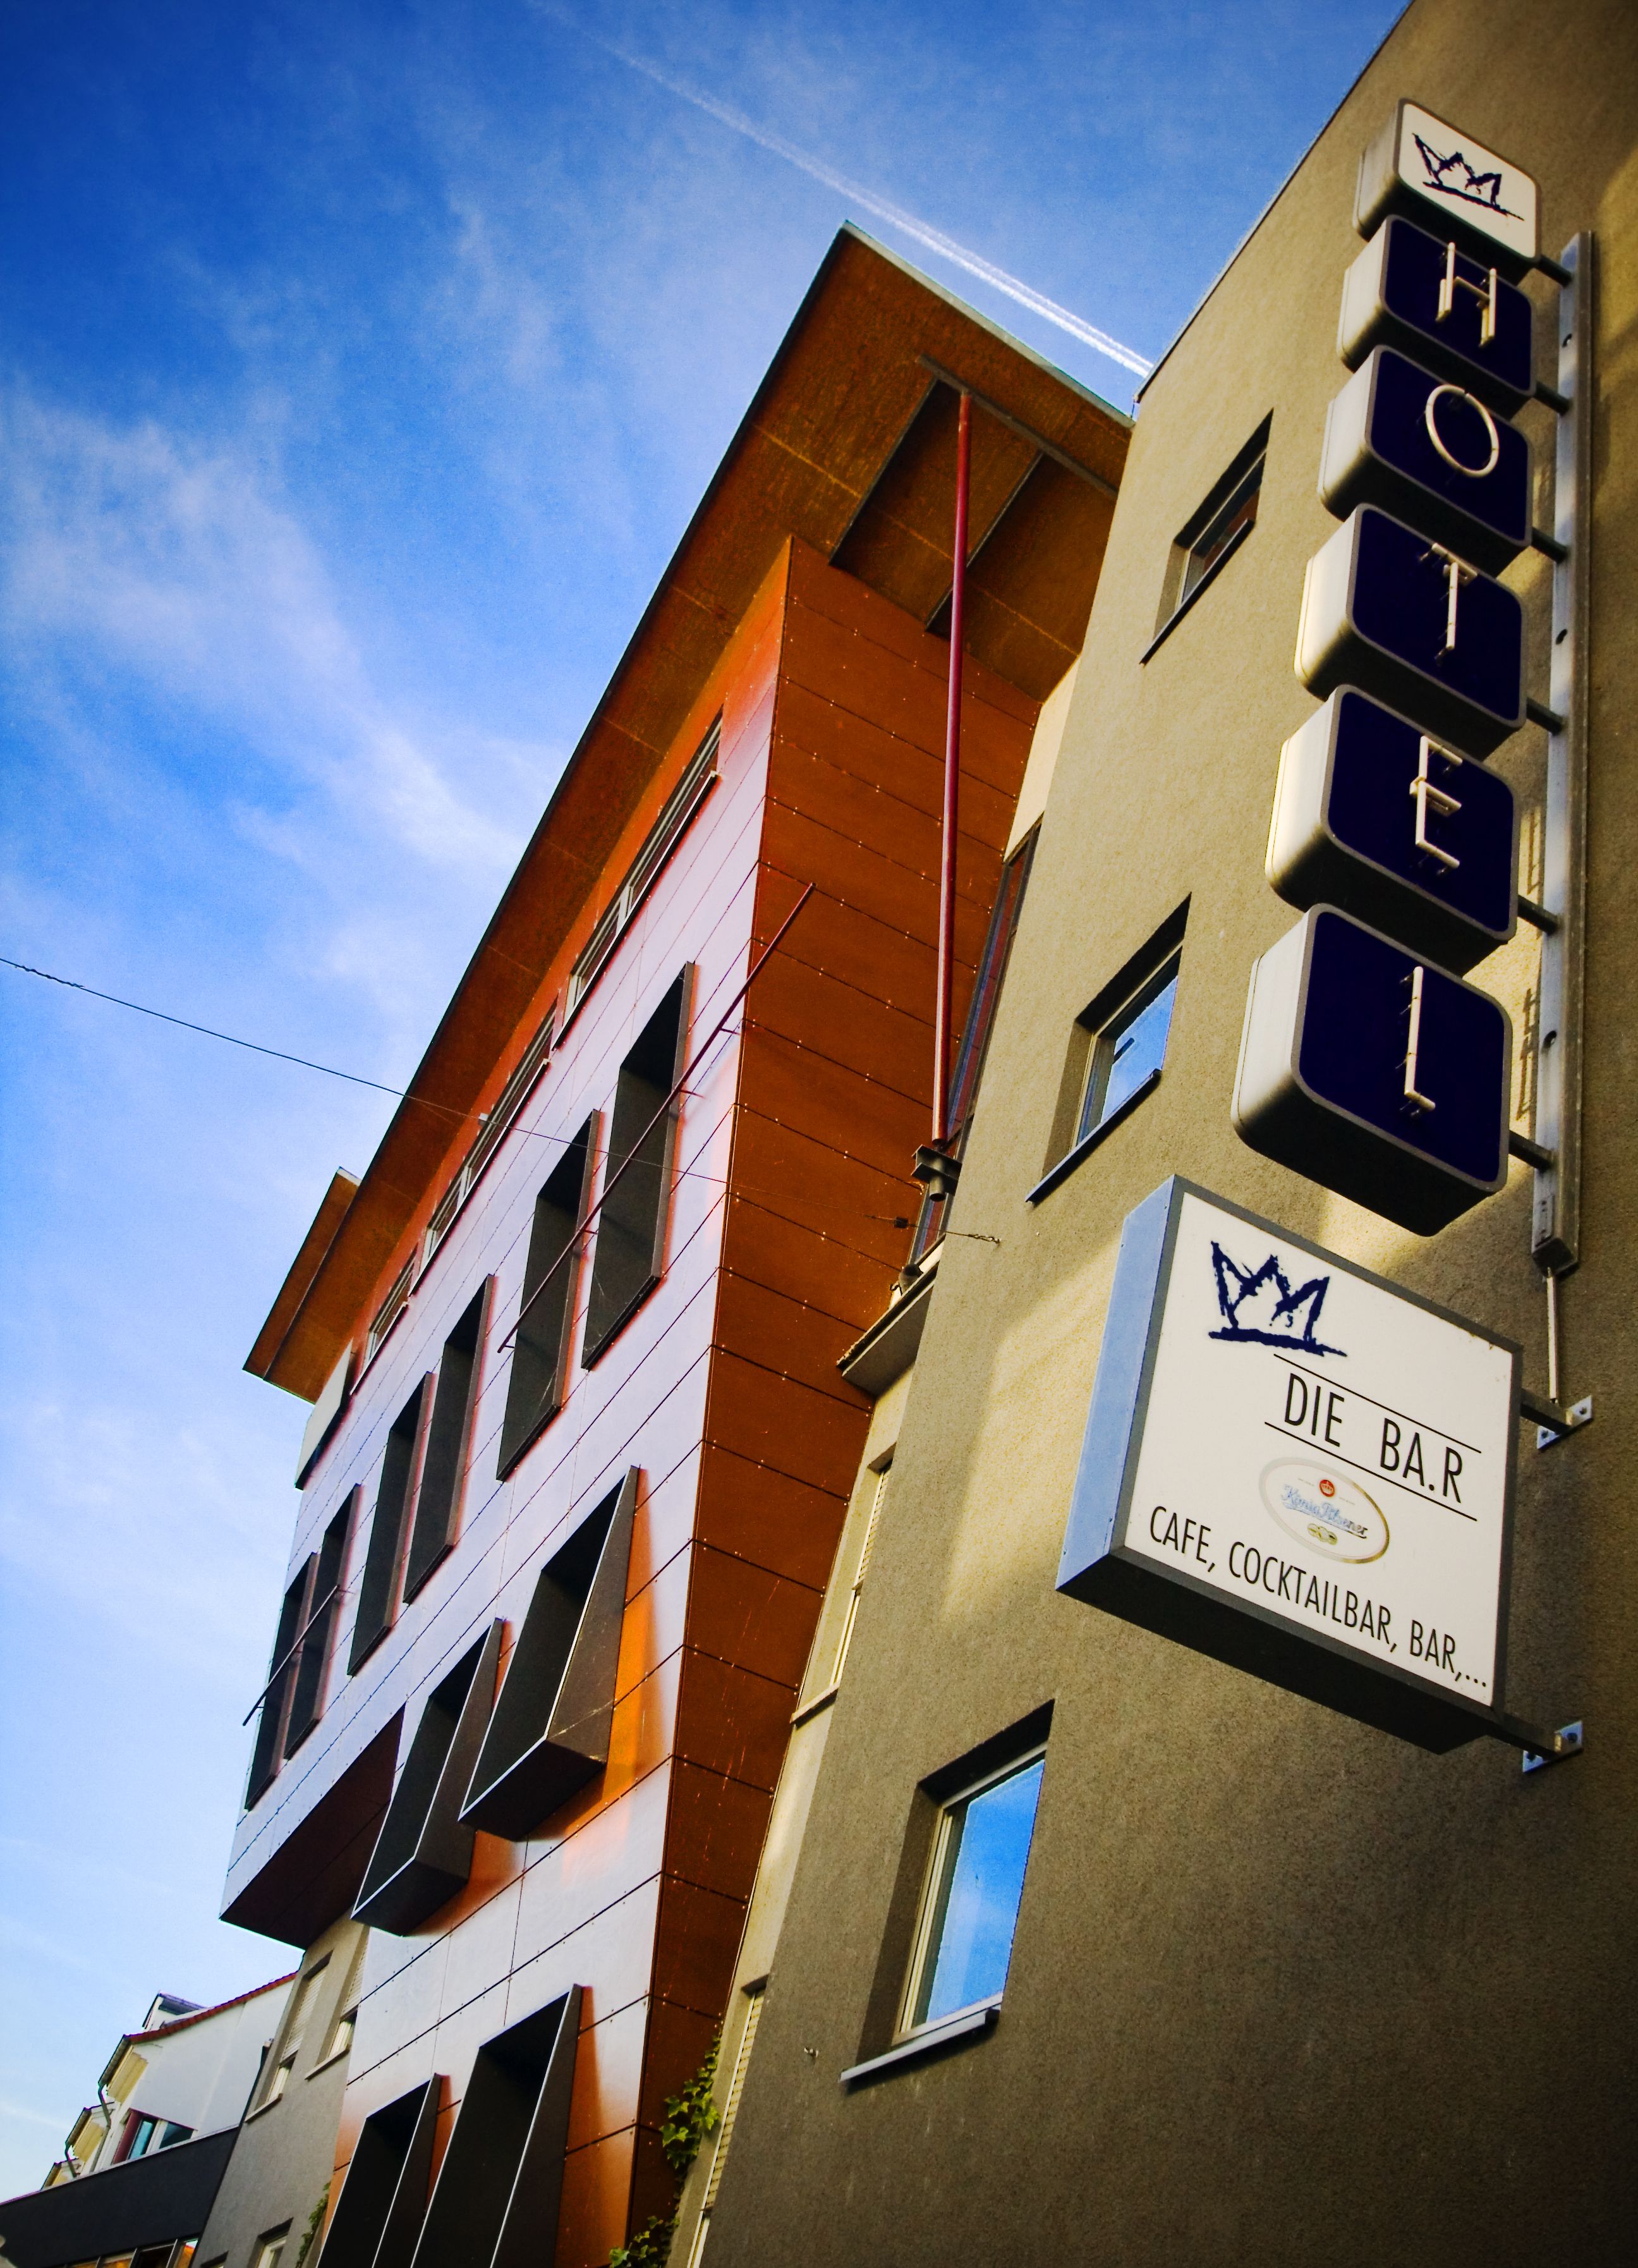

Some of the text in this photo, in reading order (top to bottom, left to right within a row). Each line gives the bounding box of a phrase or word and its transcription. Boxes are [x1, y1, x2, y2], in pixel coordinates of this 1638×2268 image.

[1405, 241, 1500, 1113] HOTEL
[1284, 1372, 1463, 1504] DIE BA.R
[1150, 1505, 1216, 1573] CAFE,
[1228, 1541, 1397, 1652] COCKTAILBAR,
